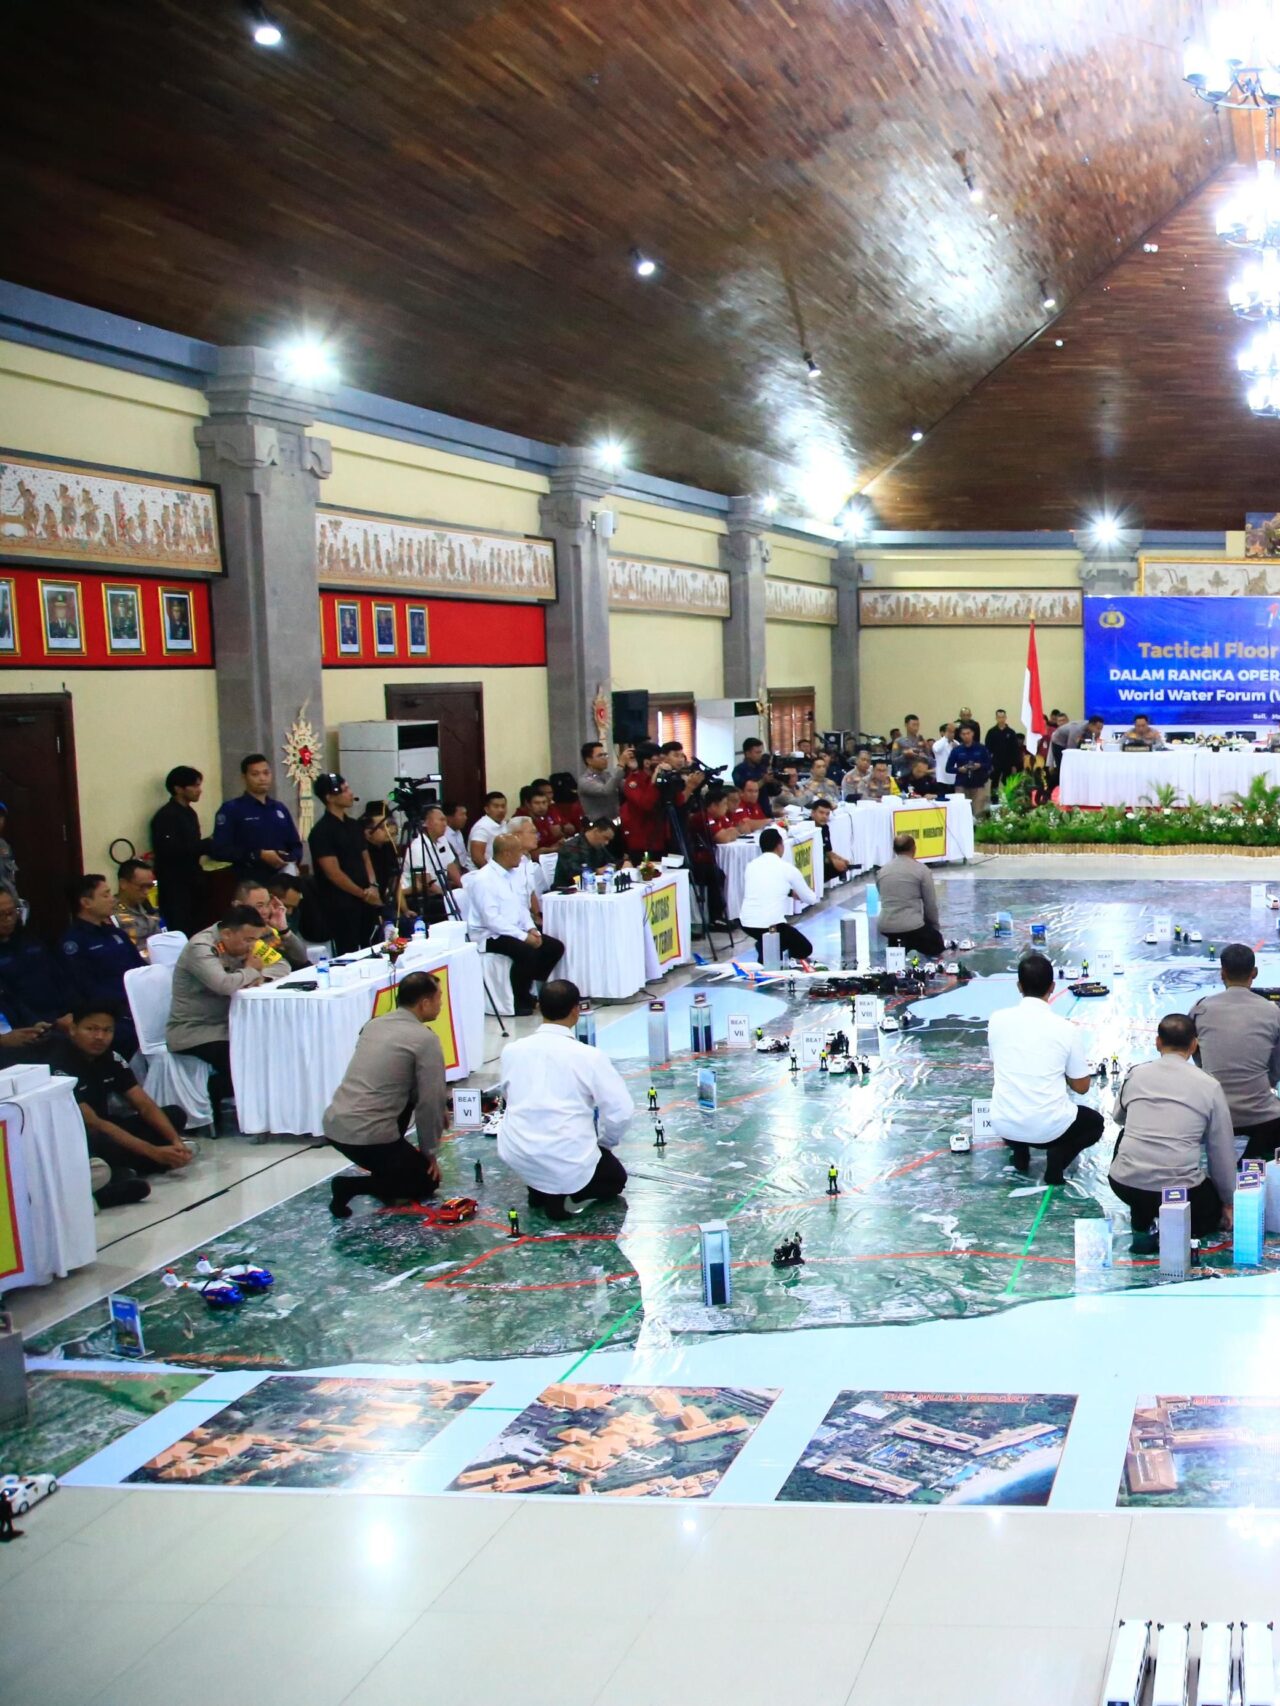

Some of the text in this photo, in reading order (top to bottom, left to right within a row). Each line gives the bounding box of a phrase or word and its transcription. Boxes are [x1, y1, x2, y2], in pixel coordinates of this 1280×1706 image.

[1138, 641, 1220, 660] Tactical
[1224, 641, 1278, 660] Floor
[1109, 669, 1165, 682] DALAM
[1168, 669, 1235, 682] RANGKA
[1118, 688, 1164, 701] World
[1167, 689, 1214, 702] Water
[1216, 690, 1266, 702] Forum
[463, 1109, 472, 1117] VI
